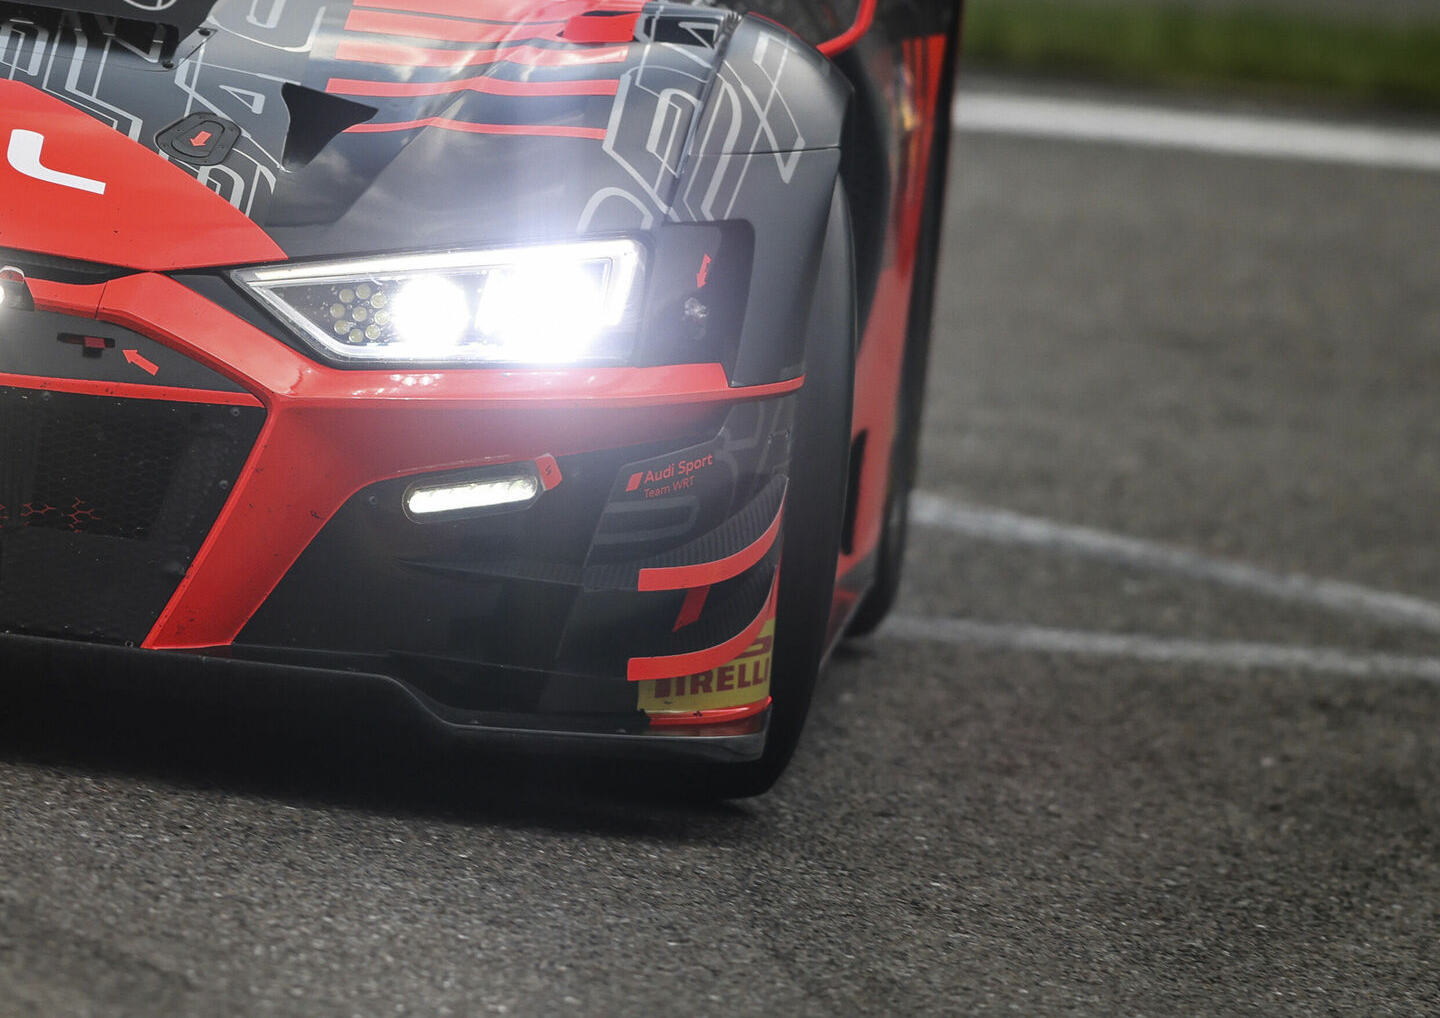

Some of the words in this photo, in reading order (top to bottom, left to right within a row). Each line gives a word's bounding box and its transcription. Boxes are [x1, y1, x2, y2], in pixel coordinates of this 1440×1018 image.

[644, 463, 675, 485] Audi
[678, 453, 713, 476] Sport
[644, 485, 671, 500] Team
[672, 475, 695, 492] WRT
